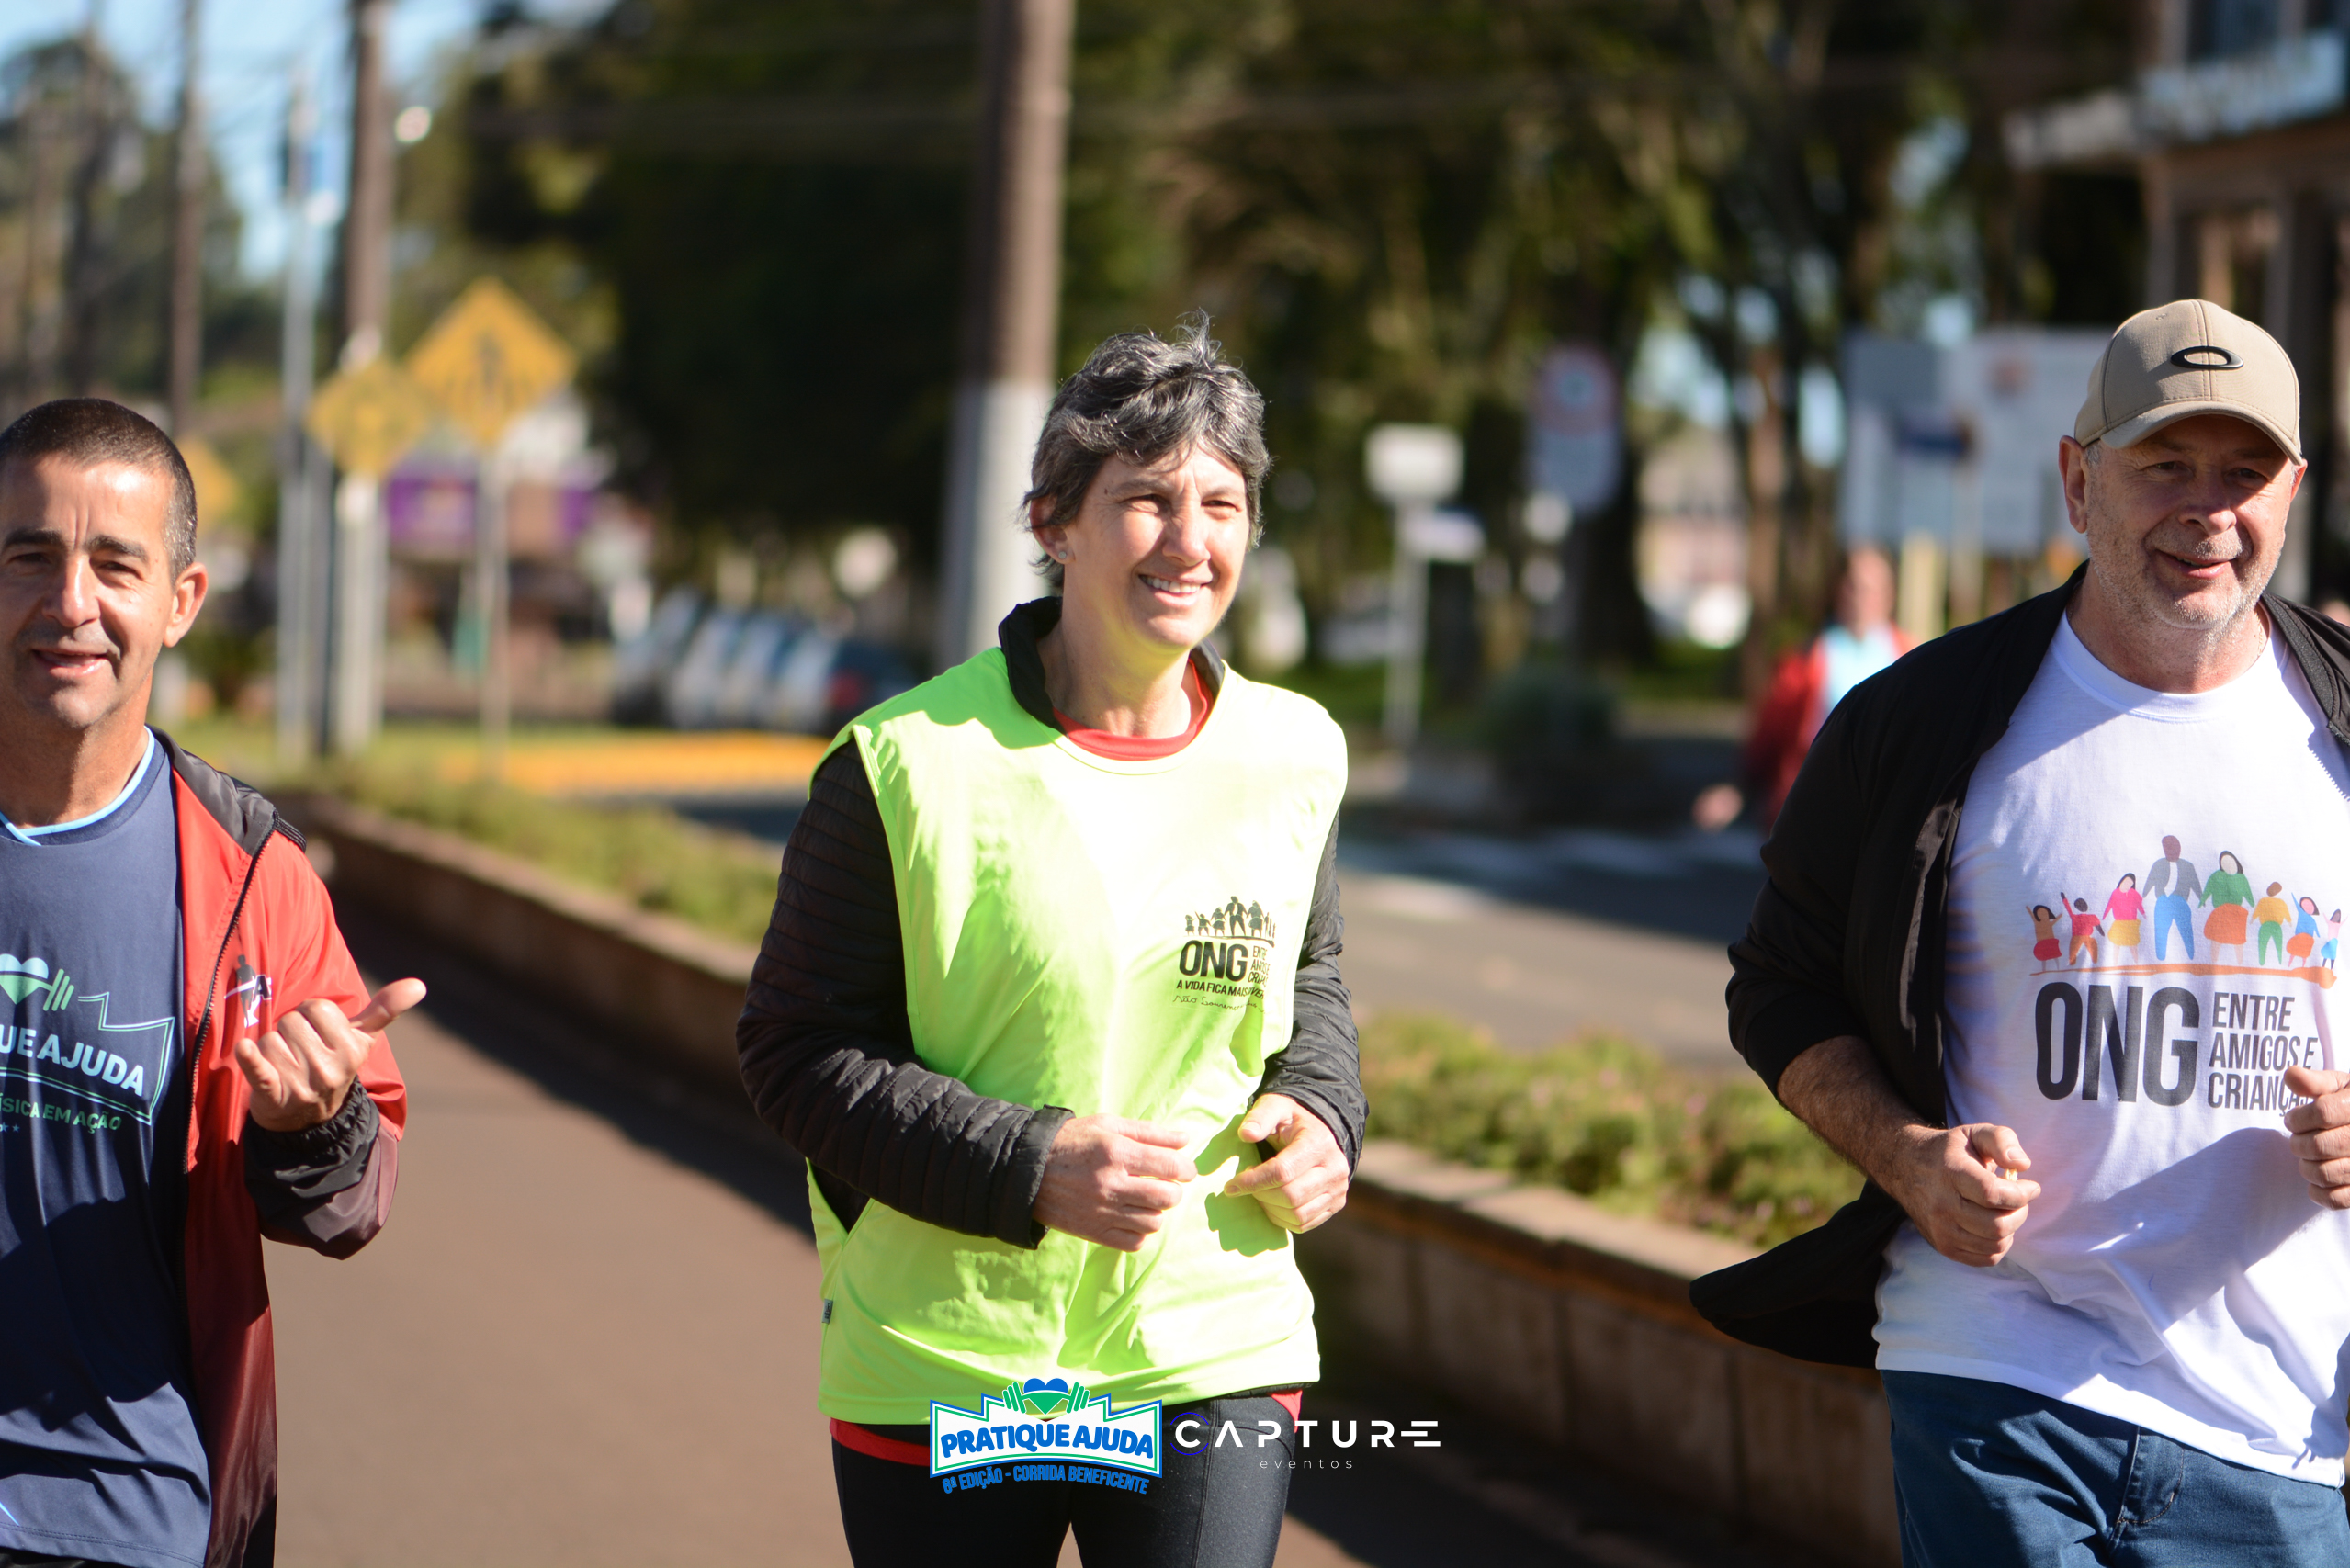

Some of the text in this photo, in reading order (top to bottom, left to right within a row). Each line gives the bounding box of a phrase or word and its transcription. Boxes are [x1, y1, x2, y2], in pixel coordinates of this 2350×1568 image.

[1179, 940, 1248, 982] ONG
[1177, 980, 1182, 989] A
[1185, 980, 1205, 991] VIDA
[1206, 982, 1226, 995] FICA
[1227, 986, 1248, 997] MAIS
[2212, 991, 2296, 1032] ENTRE
[2035, 981, 2200, 1107] ONG
[2209, 1032, 2319, 1072] AMIGOS E
[37, 1033, 144, 1097] AJUDA
[2208, 1072, 2310, 1117] CRIANÇ
[43, 1103, 71, 1123] EM
[73, 1111, 122, 1134] AÇÃO
